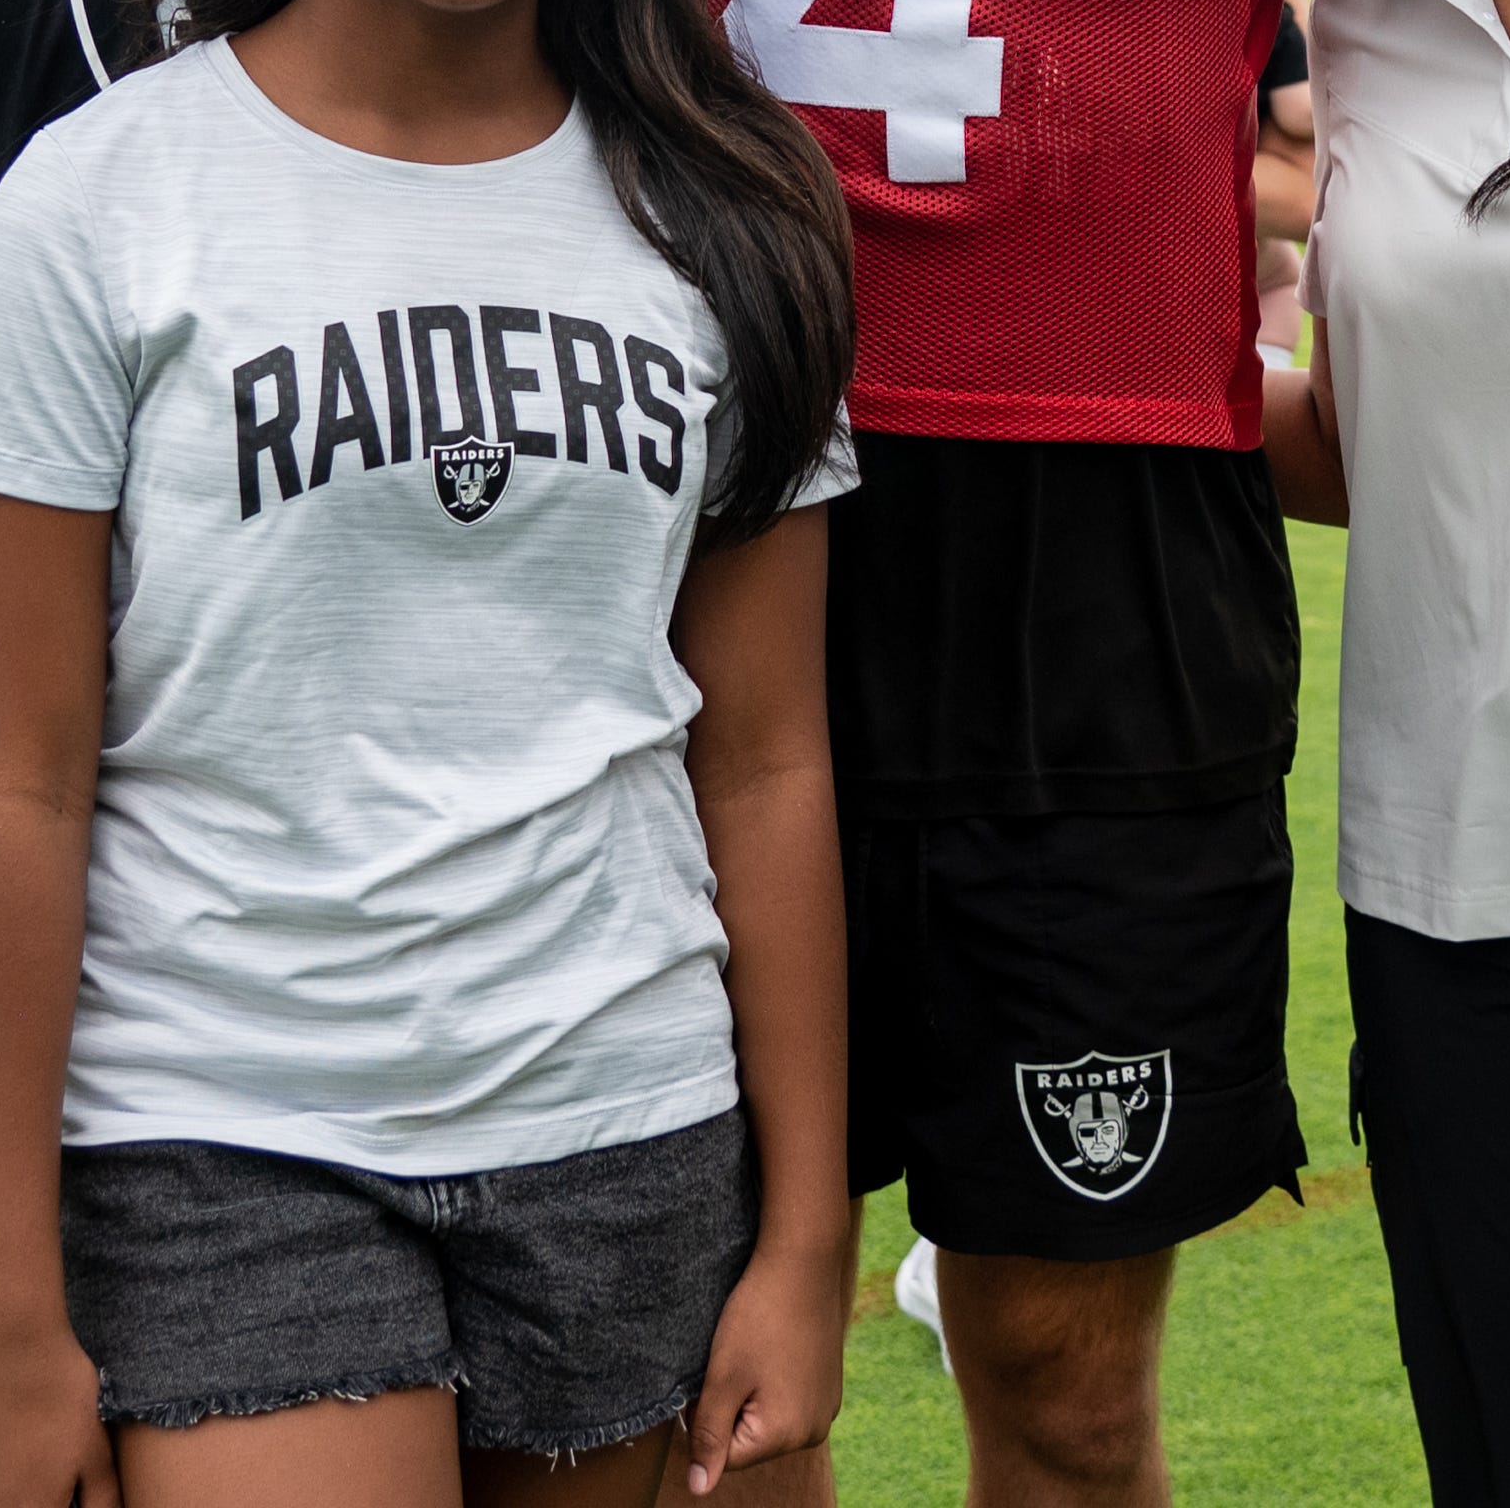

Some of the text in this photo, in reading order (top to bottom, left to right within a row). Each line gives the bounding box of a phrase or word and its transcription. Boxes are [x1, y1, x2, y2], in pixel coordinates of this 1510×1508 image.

[233, 304, 686, 522] RAIDERS
[441, 448, 505, 462] RAIDERS
[1037, 1061, 1152, 1089] RAIDERS
